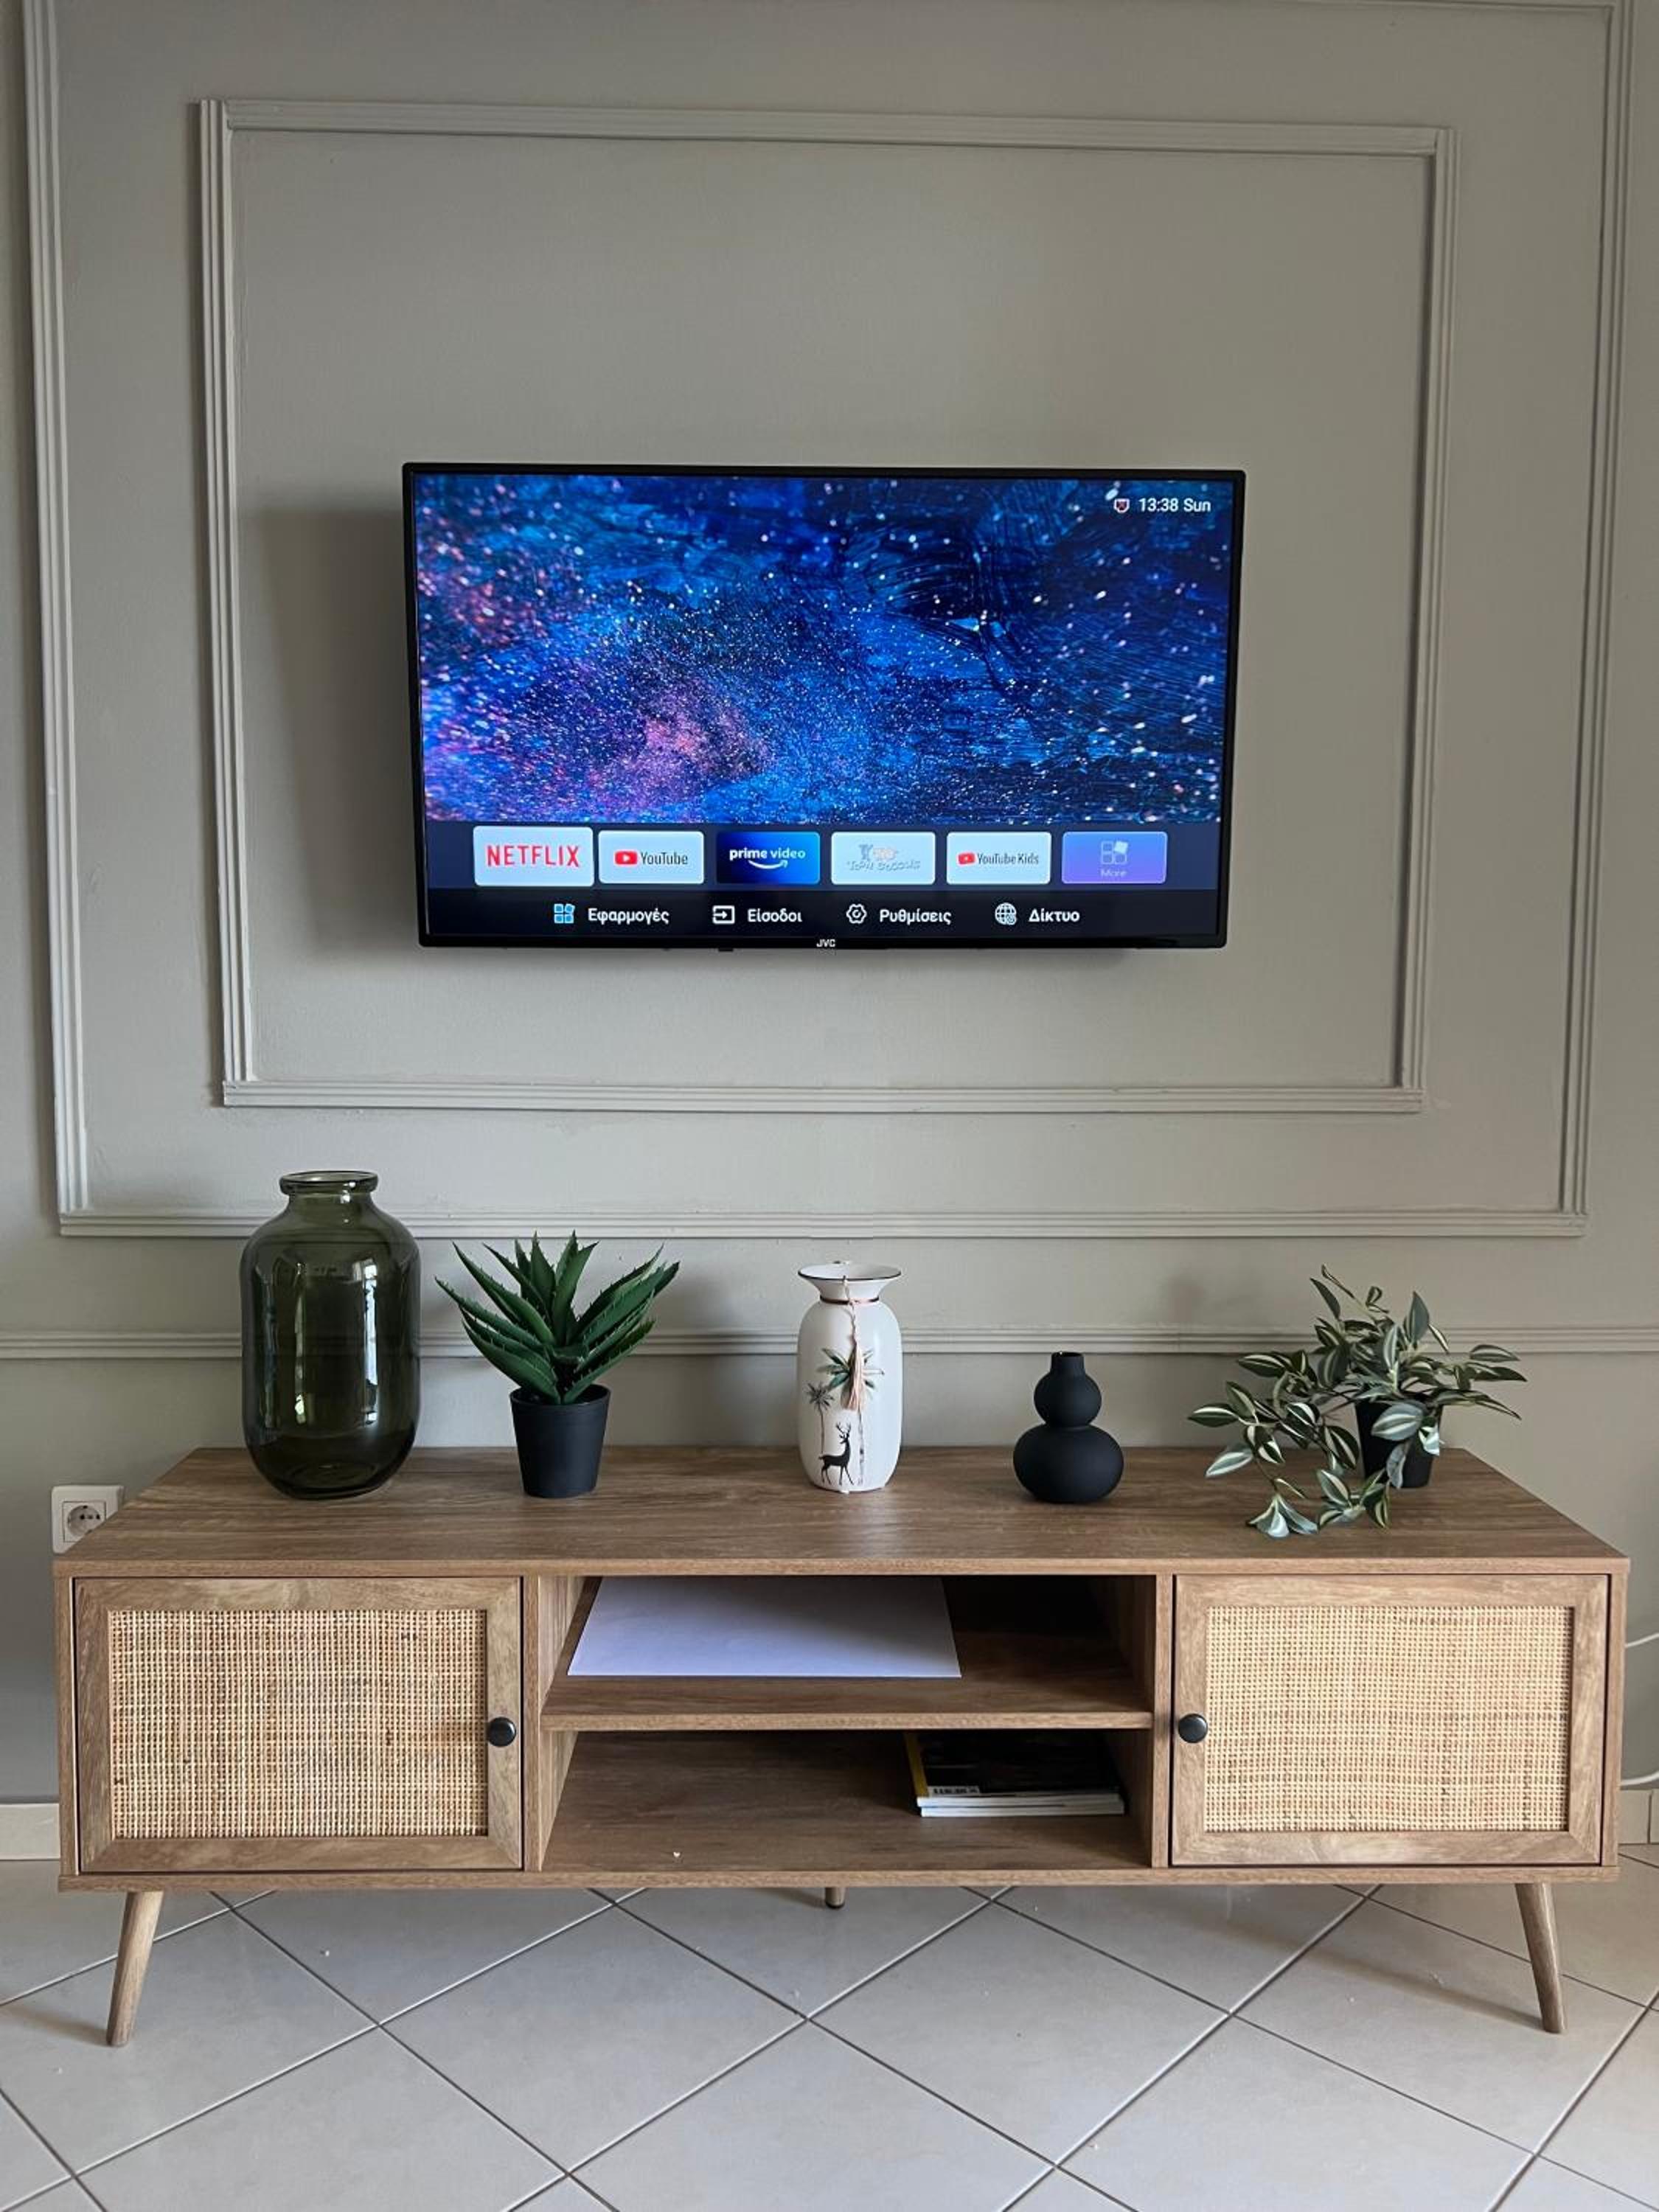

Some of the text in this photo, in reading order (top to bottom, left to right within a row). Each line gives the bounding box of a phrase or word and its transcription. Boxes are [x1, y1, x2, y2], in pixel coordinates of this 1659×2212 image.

[1138, 497, 1211, 512] 13:38 Sun
[487, 845, 580, 868] NETFLIX
[641, 852, 689, 865] YouTube
[729, 848, 806, 860] prime video
[977, 852, 1039, 865] YouTube Kids
[588, 908, 669, 924] Εφαρμογές
[747, 908, 802, 922] Είσοδοι
[880, 908, 951, 925] Ρυθμίσεις
[1029, 908, 1080, 922] Δίκτυο
[816, 939, 835, 947] JVC
